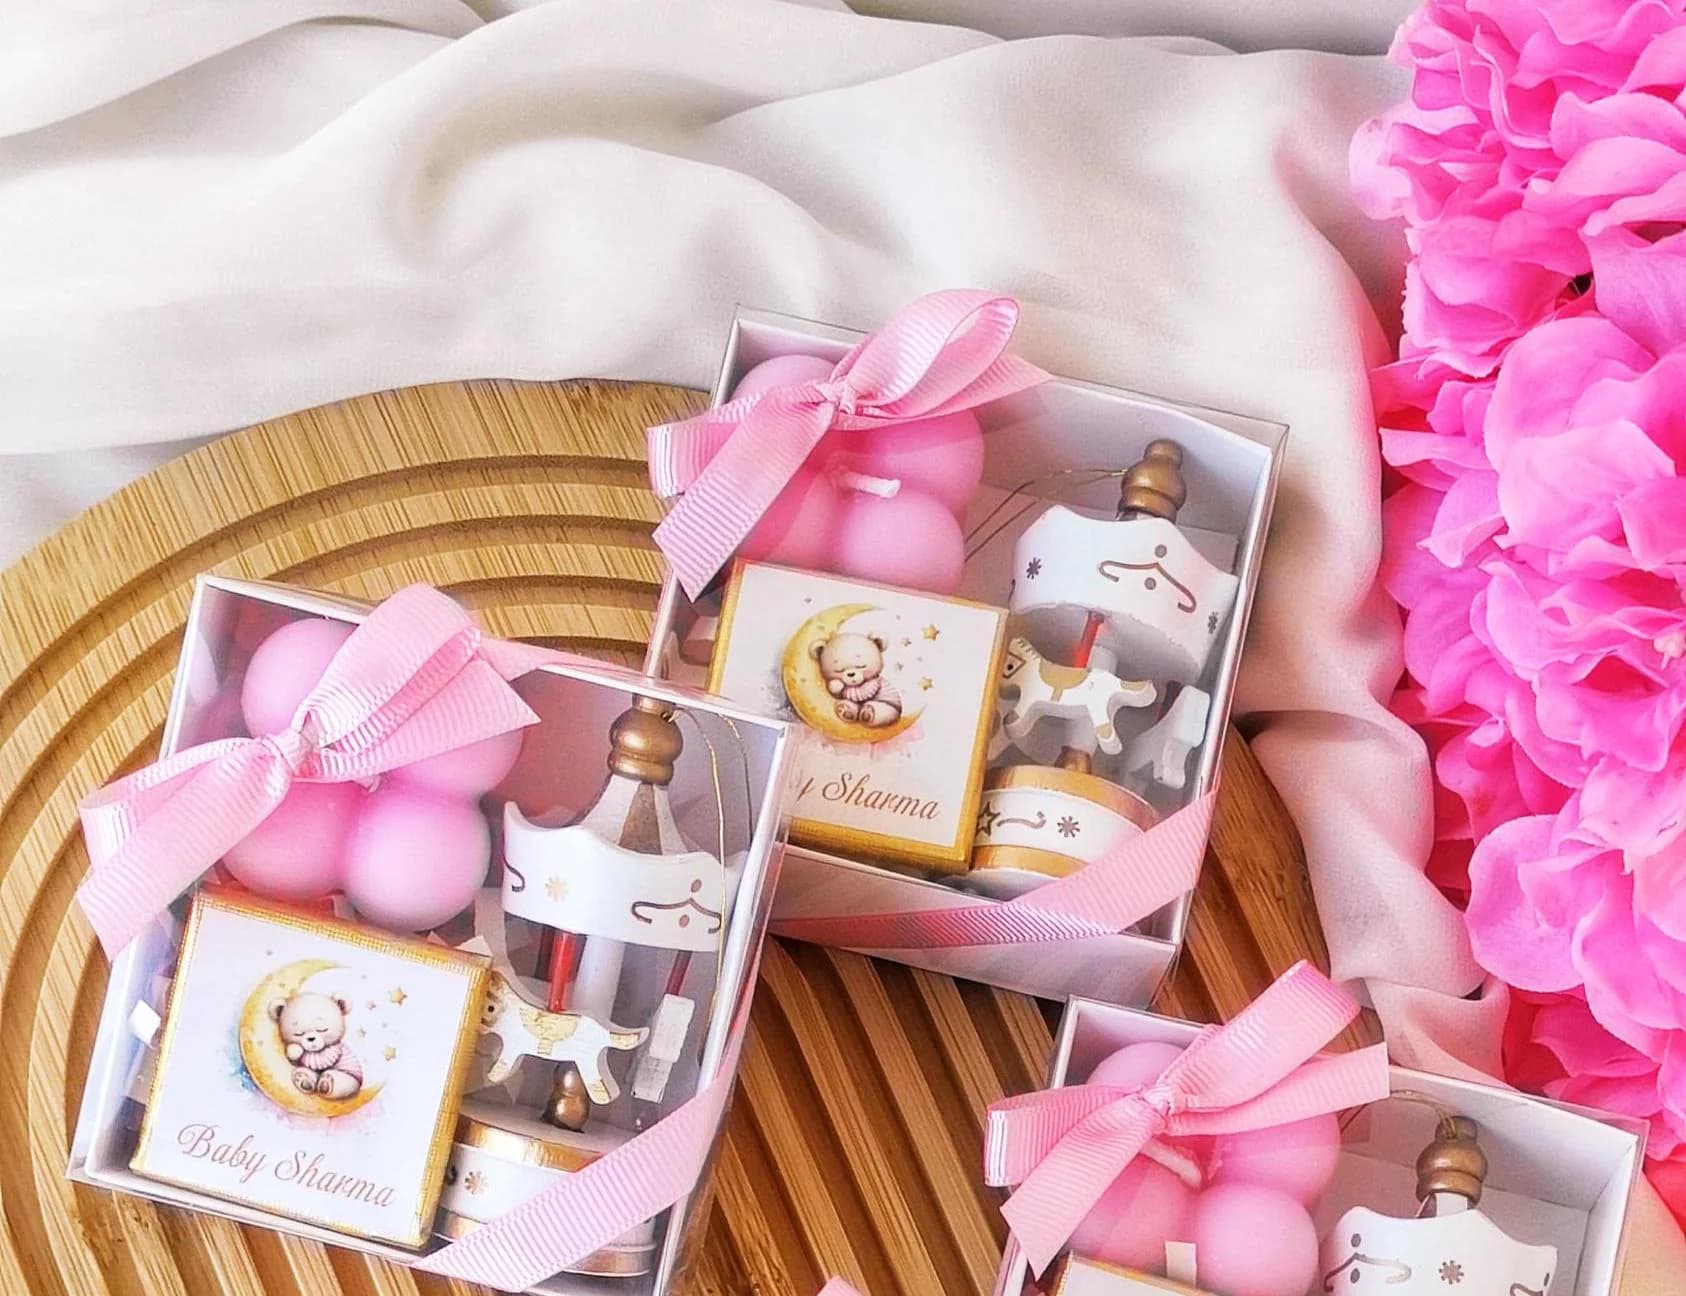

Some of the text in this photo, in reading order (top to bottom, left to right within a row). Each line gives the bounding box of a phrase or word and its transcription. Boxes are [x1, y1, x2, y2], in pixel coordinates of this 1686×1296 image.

[822, 771, 941, 820] Sharma
[177, 1123, 395, 1208] Baby Sharma
